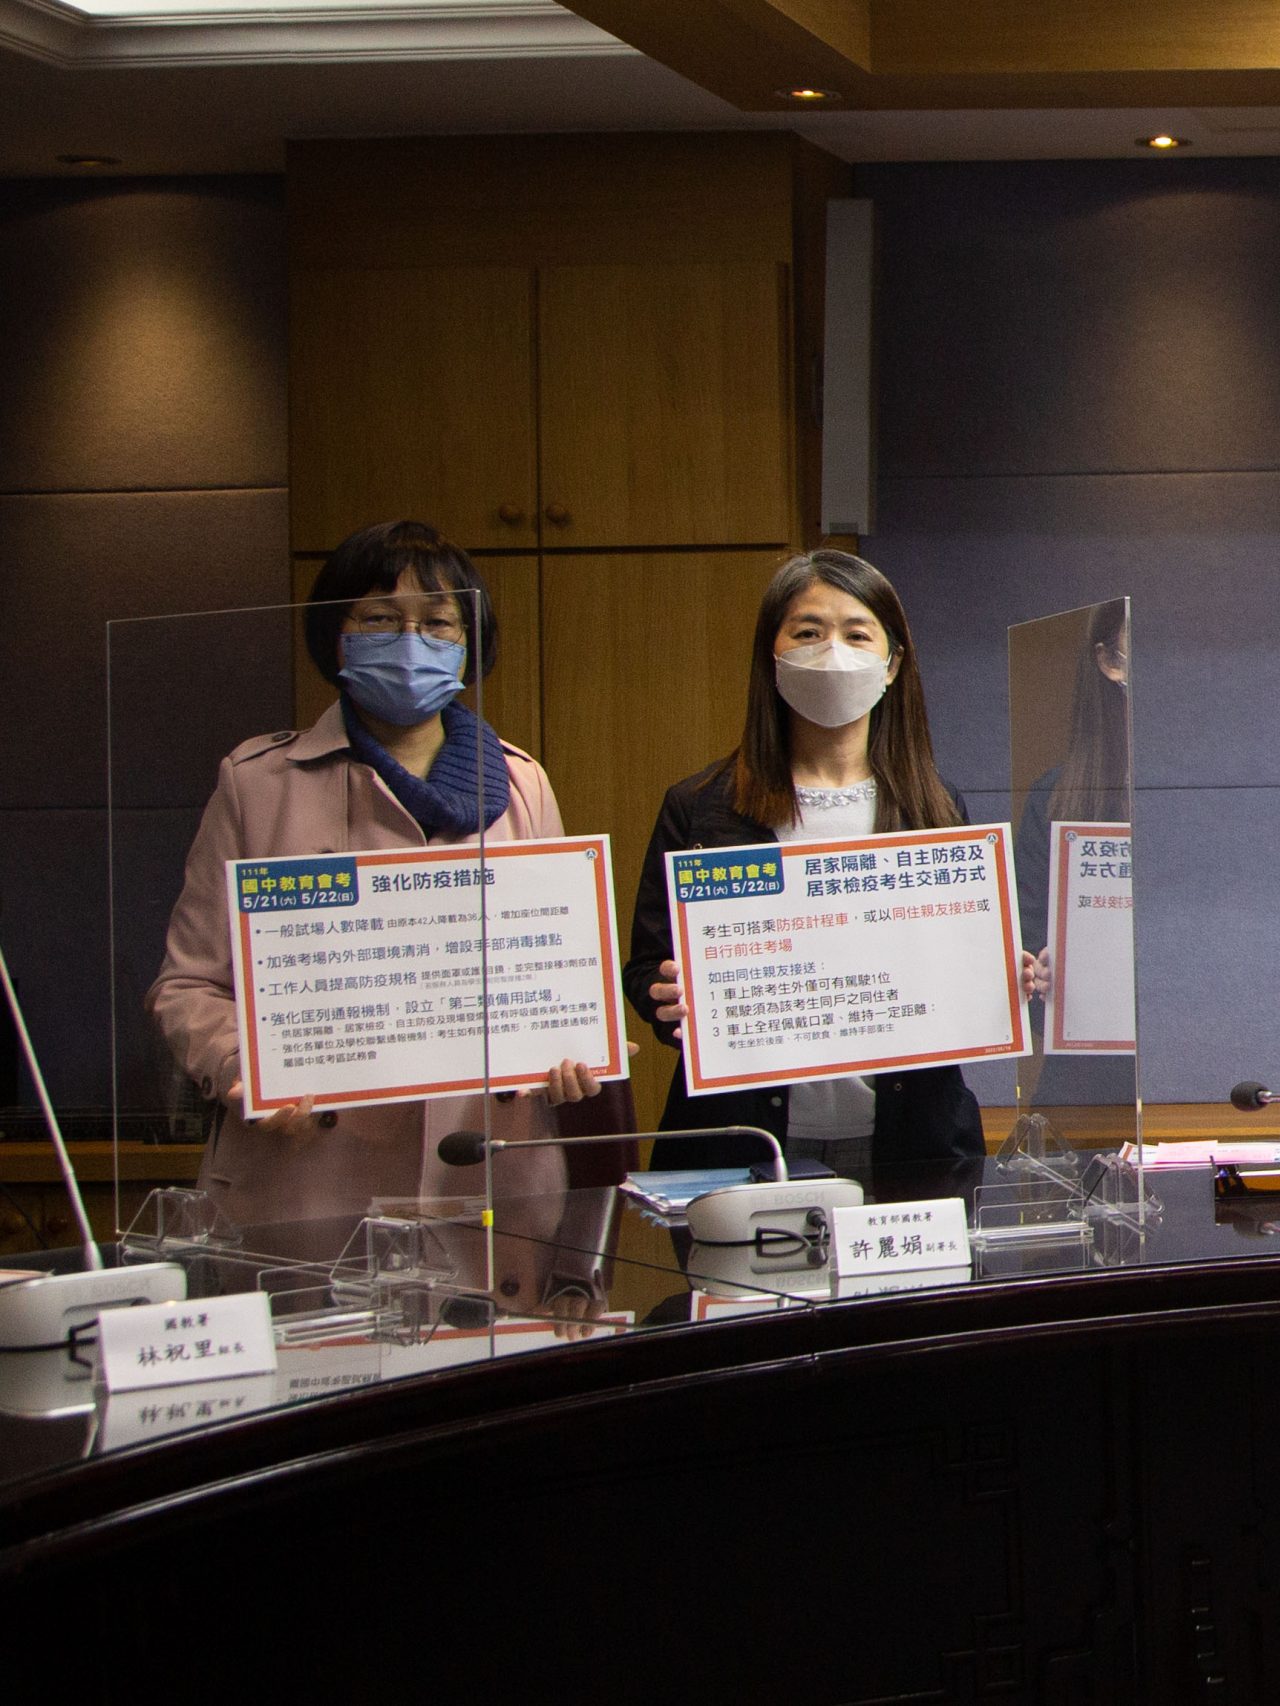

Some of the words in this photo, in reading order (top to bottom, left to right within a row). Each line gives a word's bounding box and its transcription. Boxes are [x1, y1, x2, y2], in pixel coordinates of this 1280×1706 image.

[805, 845, 984, 875] 居家隔離、自主防疫及
[242, 873, 351, 894] 國中教育會考
[372, 868, 496, 893] 強化防疫措施
[678, 863, 777, 884] 國中教育會考
[807, 865, 986, 897] 居家檢疫考生交通方式
[243, 896, 296, 909] 5/21(六)
[301, 891, 355, 905] 5/22(日)
[680, 885, 728, 899] 5/21(六)
[732, 880, 780, 894] 5/22(日)
[264, 918, 384, 938] 一般試場人數降載
[702, 899, 990, 939] 考生可搭乘防疫計程車，或以同住親友接送或
[705, 938, 793, 960] 自行前往考場
[269, 972, 417, 996] 工作人員提高防疫規格
[710, 991, 715, 1000] 1
[724, 971, 891, 1000] 車上除考生外僅可有駕駛1位
[711, 1009, 718, 1019] 2
[725, 989, 899, 1019] 駕駛須為該考生同戶之同住者
[713, 1027, 720, 1037] 3
[867, 1211, 934, 1227] 教育部國教署
[849, 1234, 922, 1260] 許麗娟
